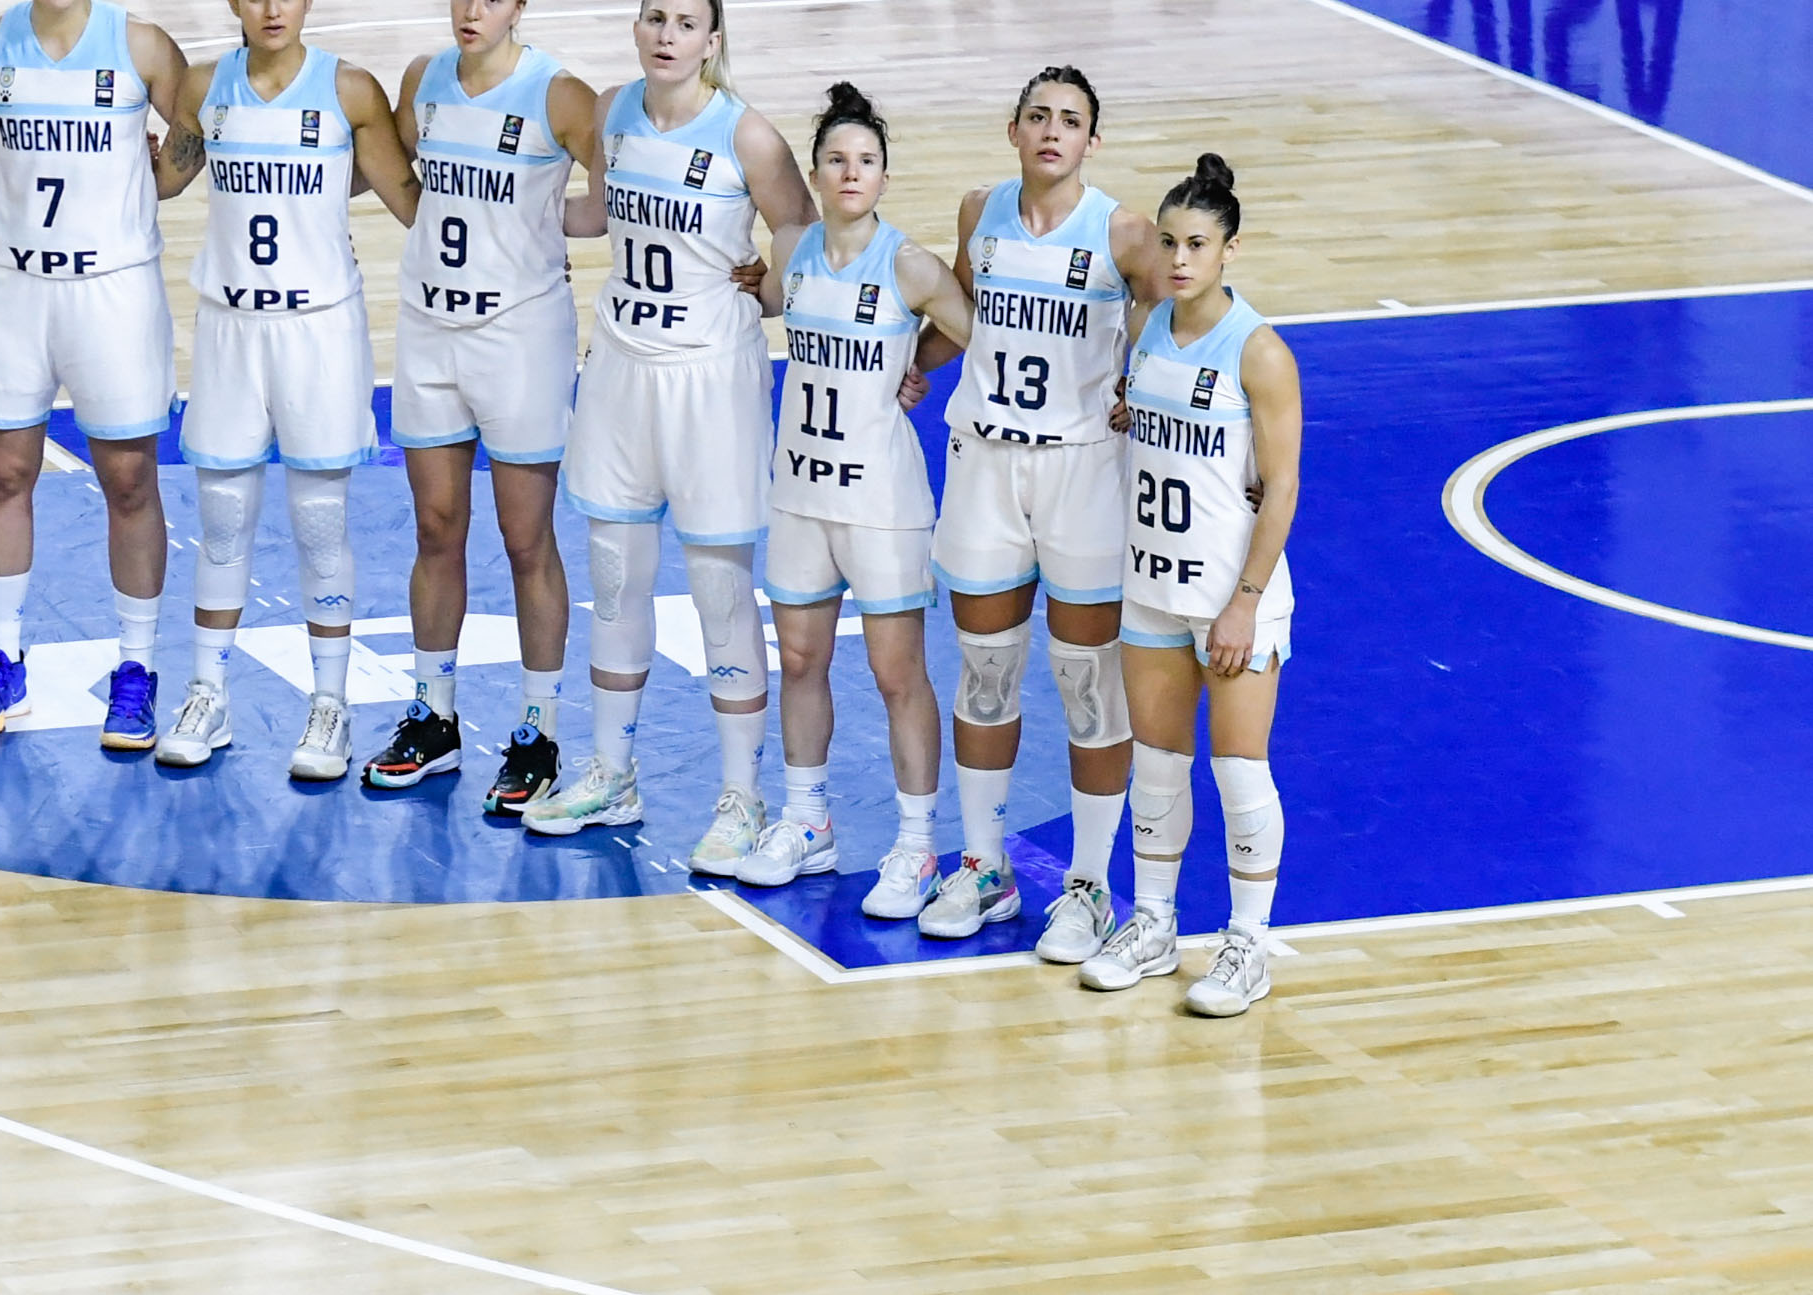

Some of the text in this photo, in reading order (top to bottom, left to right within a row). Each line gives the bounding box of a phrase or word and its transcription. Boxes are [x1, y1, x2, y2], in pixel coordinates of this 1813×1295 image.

[210, 159, 323, 195] ARGENTINA
[37, 177, 65, 228] 7
[9, 247, 97, 275] YPF
[249, 214, 278, 266] 8
[440, 216, 468, 269] 9
[622, 237, 674, 294] 10
[223, 285, 309, 311] YPF
[421, 282, 501, 316] YPF
[612, 296, 688, 329] YPF
[987, 351, 1050, 411] 13
[800, 382, 845, 441] 11
[787, 449, 864, 487] YPF
[1137, 469, 1191, 534] 20
[1130, 544, 1204, 584] YPF
